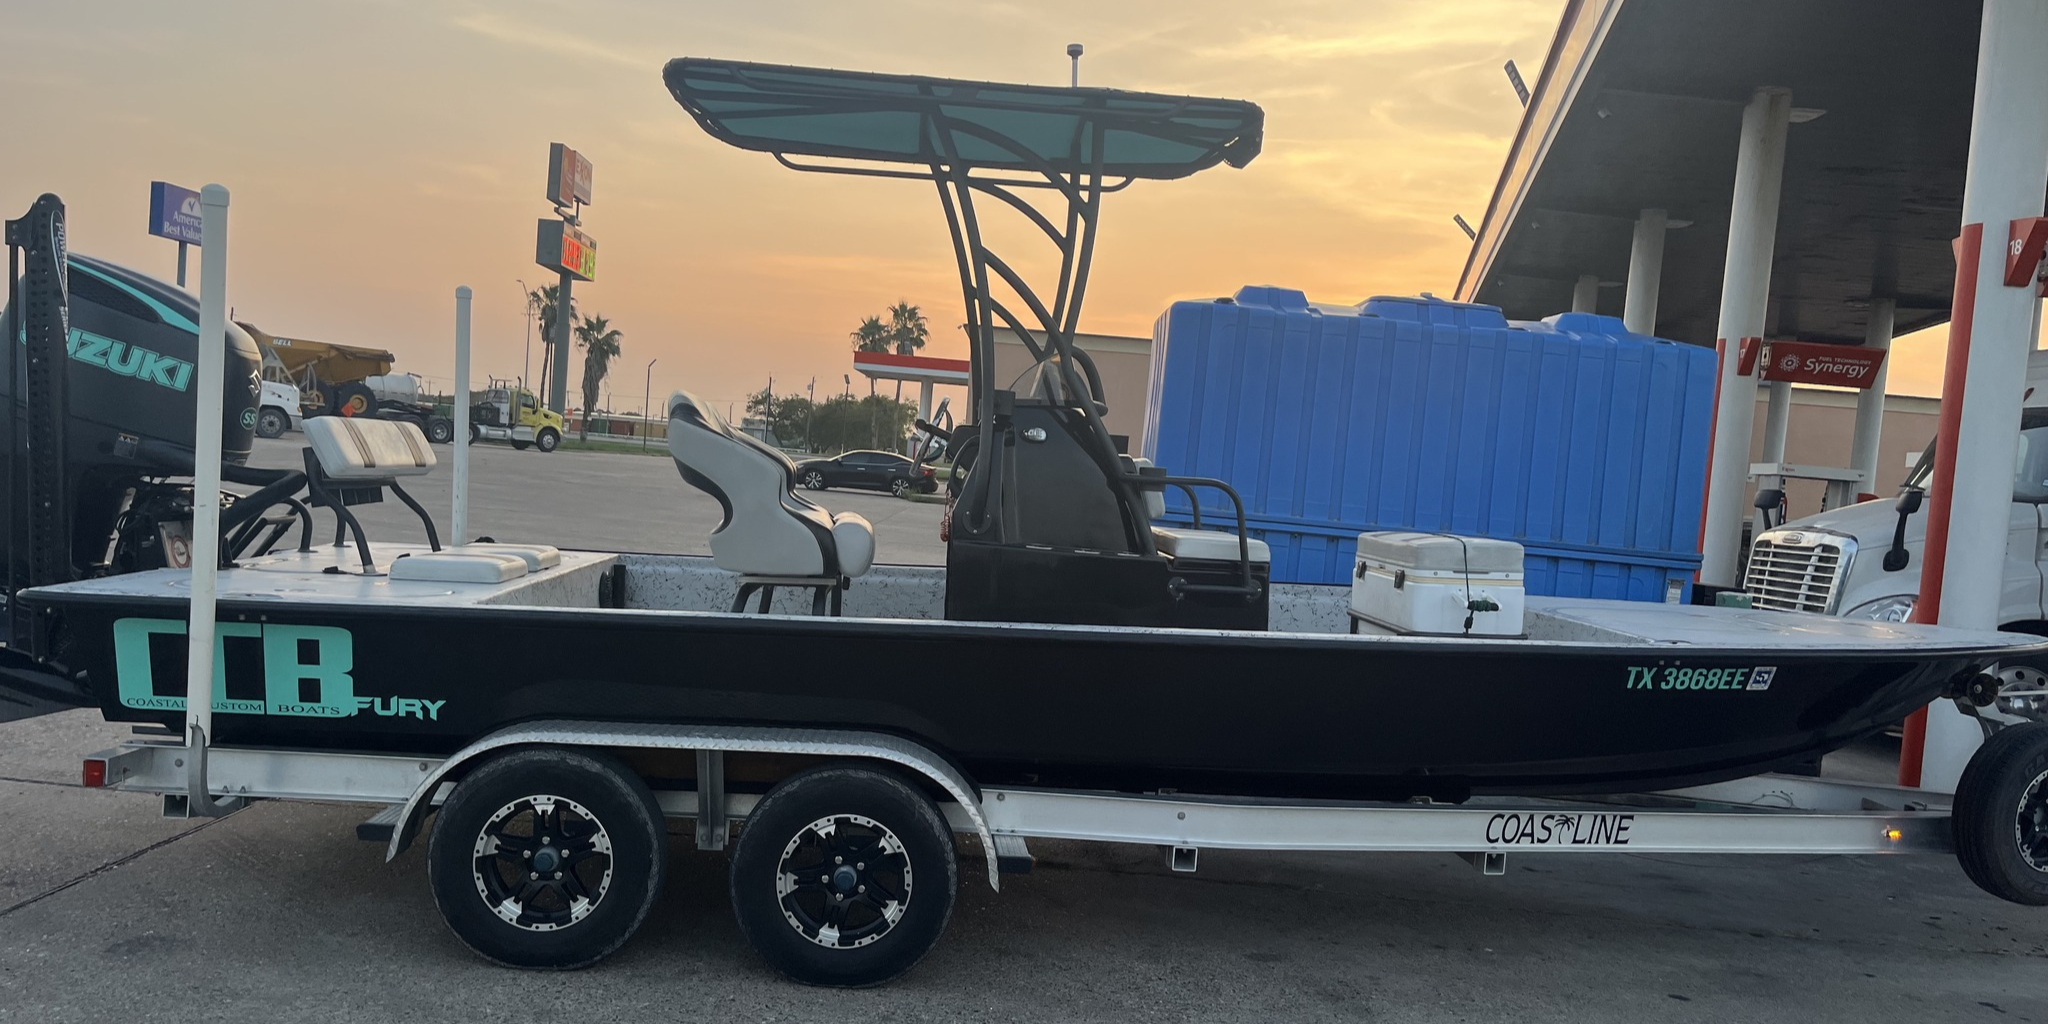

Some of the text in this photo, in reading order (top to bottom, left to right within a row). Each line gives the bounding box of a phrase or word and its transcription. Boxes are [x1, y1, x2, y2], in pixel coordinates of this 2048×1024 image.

[164, 221, 180, 236] Best
[2010, 238, 2023, 255] 18
[20, 320, 194, 392] ZUKI
[1834, 357, 1872, 365] TECHNOLOGY
[1804, 358, 1869, 378] Synergy
[1627, 667, 1657, 690] TX
[1660, 667, 1749, 690] 3868EE
[127, 697, 340, 715] COASTAL USTOM BOATS
[351, 695, 447, 721] FURY
